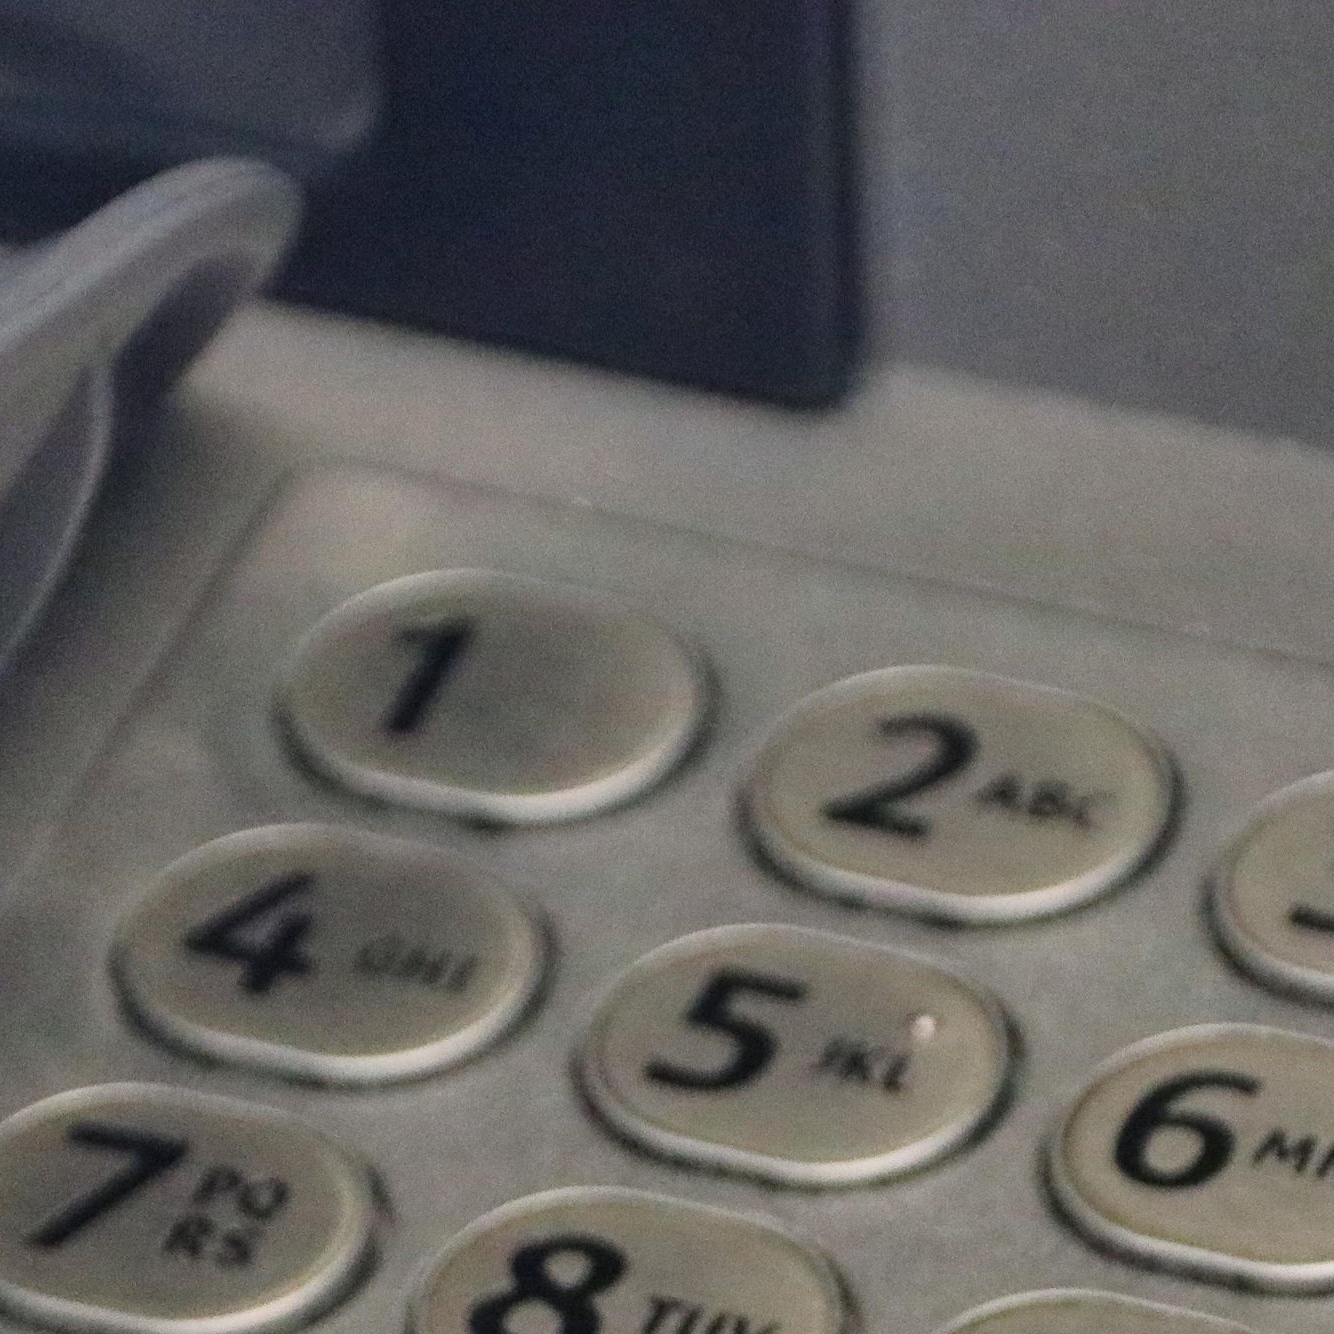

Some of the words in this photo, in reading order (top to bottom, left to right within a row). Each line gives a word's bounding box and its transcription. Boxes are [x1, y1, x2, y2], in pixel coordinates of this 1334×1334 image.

[383, 614, 479, 736] 1
[819, 710, 979, 840] 2
[182, 870, 315, 996] 4
[641, 965, 807, 1093] 5
[25, 1118, 190, 1252] 7
[1113, 1068, 1263, 1192] 6
